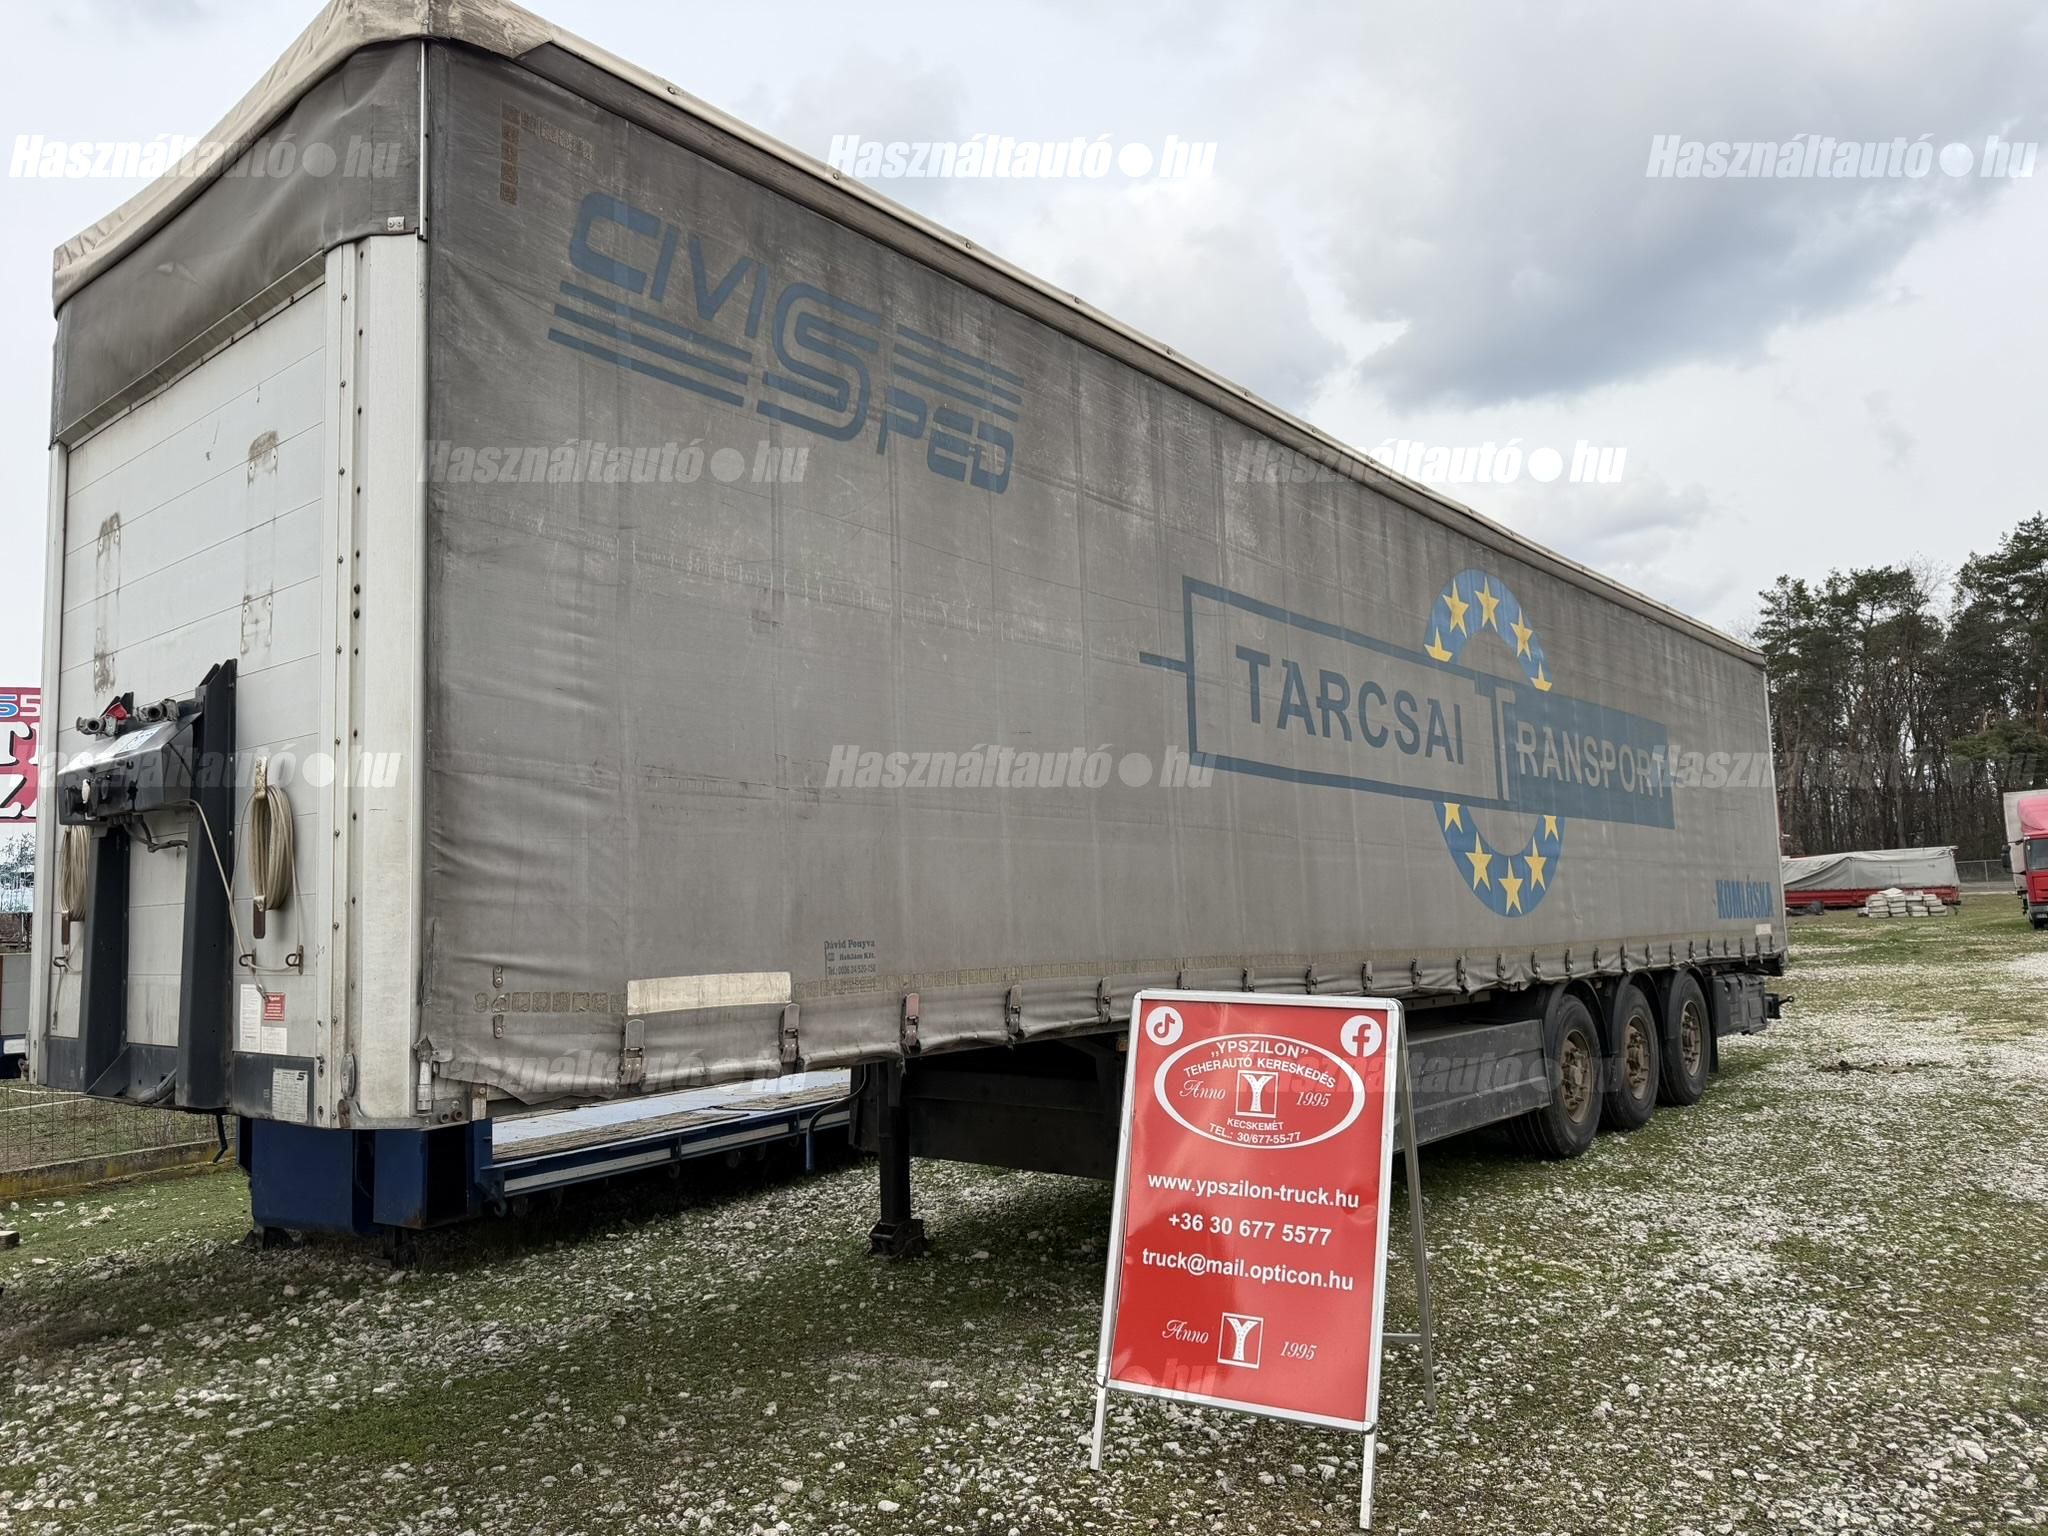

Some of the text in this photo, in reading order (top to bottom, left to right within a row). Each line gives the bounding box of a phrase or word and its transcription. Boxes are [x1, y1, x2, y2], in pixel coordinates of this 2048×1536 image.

[1235, 645, 1465, 766] TARCSAI
[1475, 672, 1666, 801] TRANSPORT
[1715, 875, 1776, 920] KOMLÓSKA
[1184, 1057, 1336, 1089] TEHERAUTÓ KERESKEDÉS
[1179, 1079, 1226, 1101] Anno
[1296, 1091, 1332, 1108] 1995
[1208, 1123, 1301, 1145] TEL.: 30/677-55-77
[1226, 1117, 1284, 1131] KECSKEMÉT
[1147, 1174, 1359, 1209] www.ypszilon-truck.hu
[1168, 1212, 1332, 1246] +36 30 677 5577
[1142, 1248, 1354, 1291] truck@mail.opticon.hu
[1161, 1319, 1209, 1345] Anno
[1280, 1341, 1318, 1361] 1995
